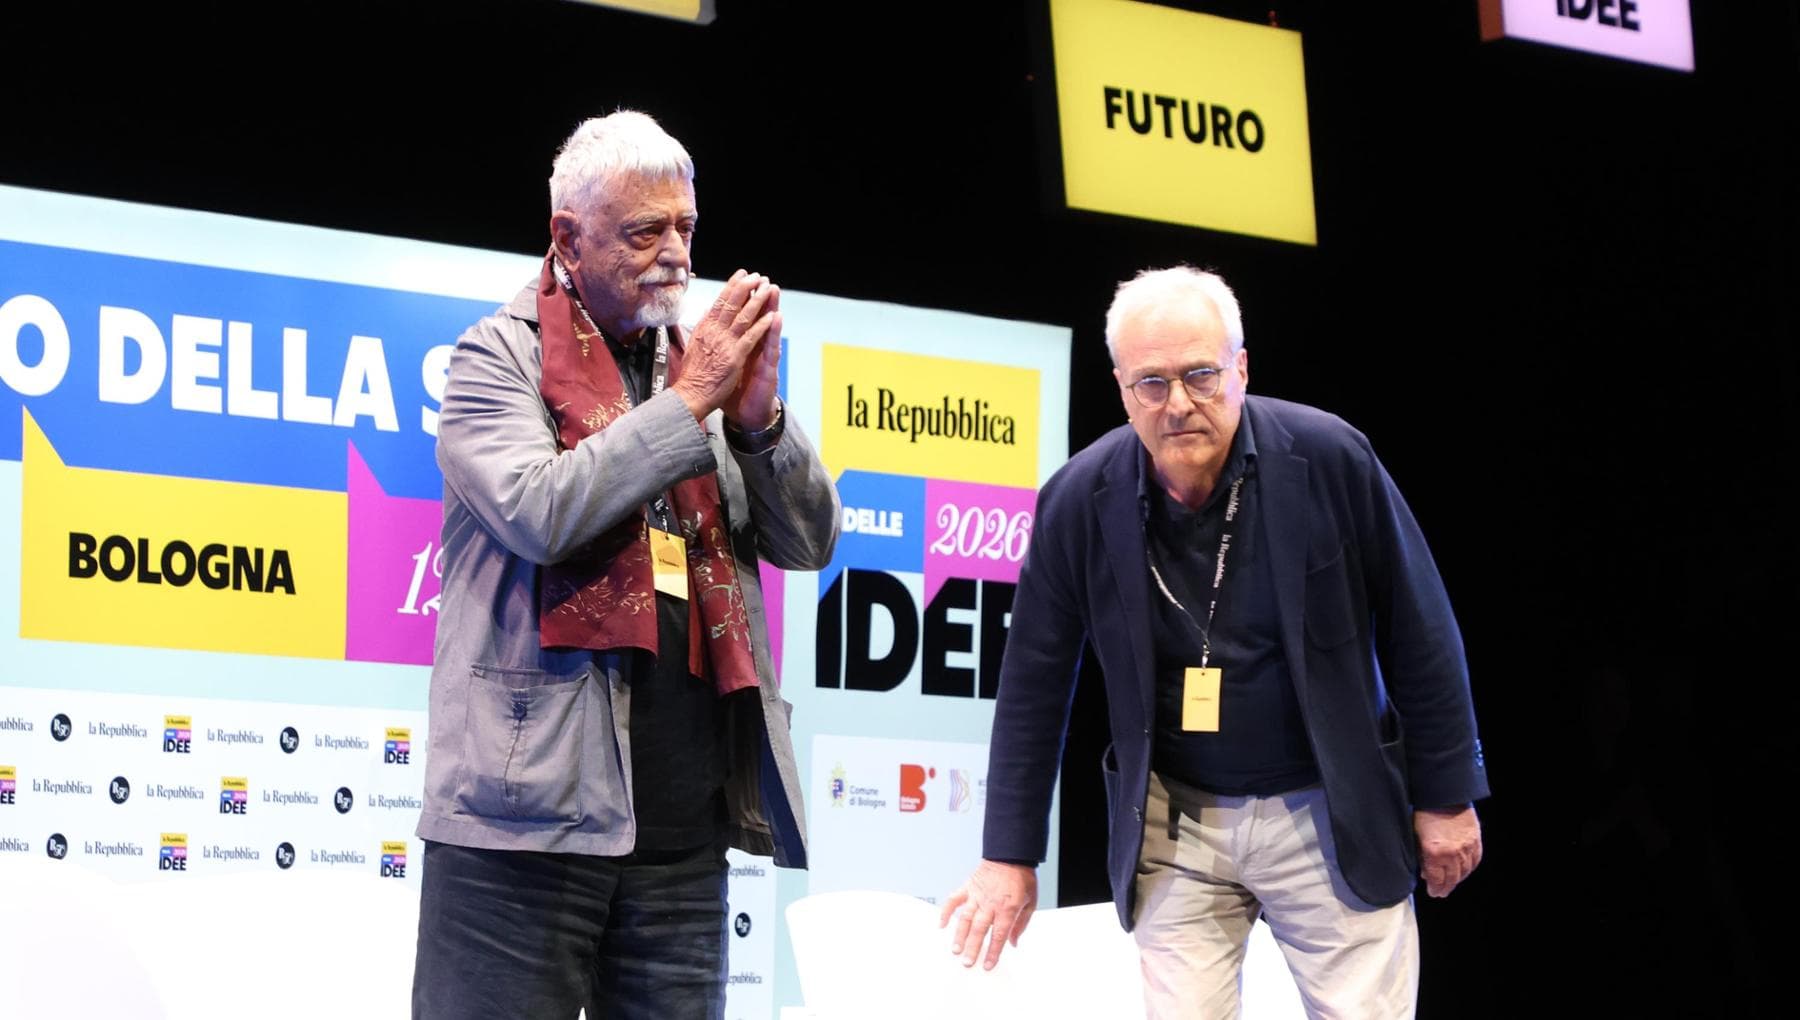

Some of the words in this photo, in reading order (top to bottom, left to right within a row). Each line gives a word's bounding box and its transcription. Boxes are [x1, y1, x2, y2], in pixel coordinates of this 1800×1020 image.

[1104, 86, 1265, 153] FUTURO
[99, 305, 399, 432] DELLA
[847, 384, 869, 429] la
[877, 388, 1016, 445] Repubblica
[841, 506, 904, 537] DELLE
[930, 504, 1032, 562] 2026
[69, 532, 296, 595] BOLOGNA
[0, 717, 33, 731] ubblica
[88, 721, 97, 735] la
[99, 722, 148, 738] Repubblica
[207, 728, 216, 742] la
[217, 729, 264, 745] Repubblica
[324, 734, 369, 750] Repubblica
[163, 739, 191, 753] IDEE
[384, 750, 409, 764] IDEE
[33, 778, 41, 792] la
[43, 779, 93, 795] Repubblica
[147, 784, 155, 797] la
[156, 784, 205, 800] Repubblica
[0, 790, 16, 804] EE
[272, 790, 319, 806] Repubblica
[377, 795, 422, 810] Repubblica
[220, 800, 247, 814] IDEE
[85, 841, 93, 854] la
[95, 841, 143, 857] Repubblica
[203, 845, 211, 859] la
[212, 846, 260, 862] Repubblica
[320, 849, 366, 865] Repubblica
[159, 857, 187, 871] IDEE
[380, 864, 406, 878] IDEE
